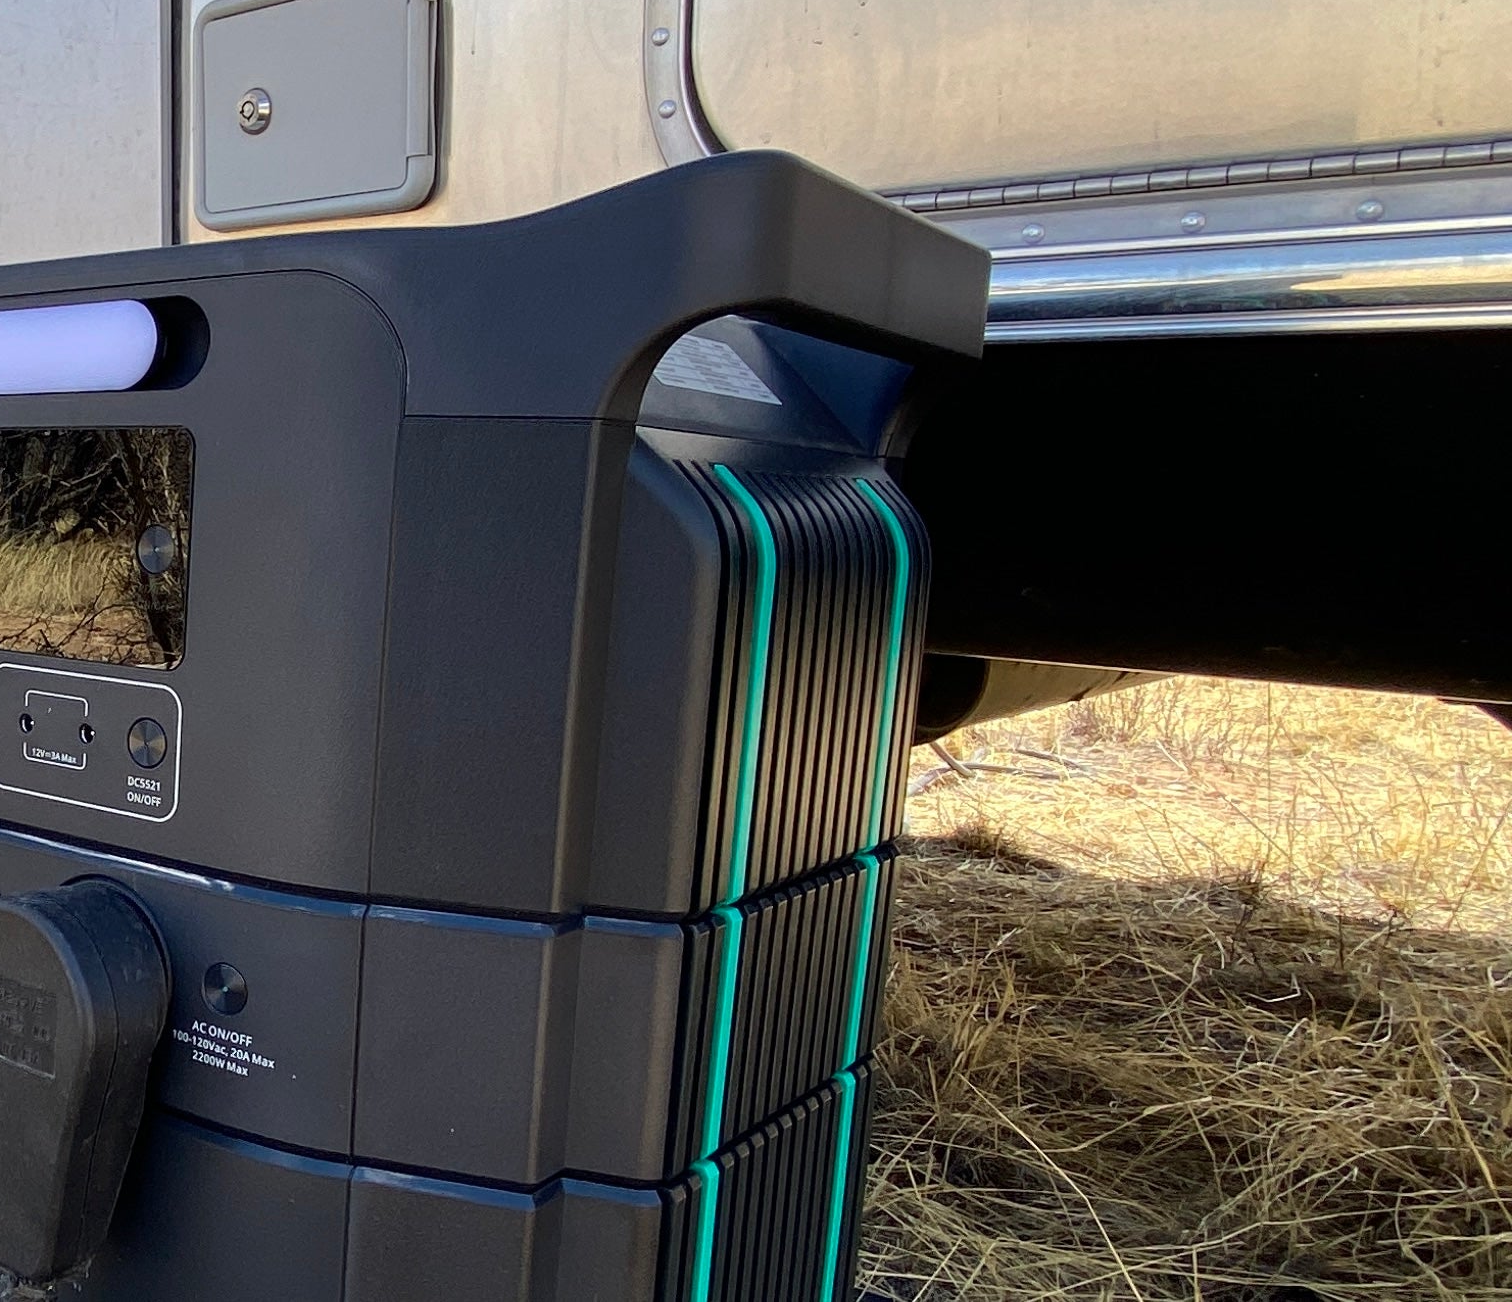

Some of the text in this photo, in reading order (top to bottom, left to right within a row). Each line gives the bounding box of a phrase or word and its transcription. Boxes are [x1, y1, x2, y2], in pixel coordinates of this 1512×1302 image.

[61, 754, 77, 764] Max
[127, 776, 161, 791] DC5521
[127, 792, 162, 807] ON/OFF
[191, 1020, 253, 1047] AC ON/OFF
[192, 1049, 249, 1077] 2200W Max
[230, 1047, 251, 1063] 20A
[251, 1053, 275, 1069] Max
